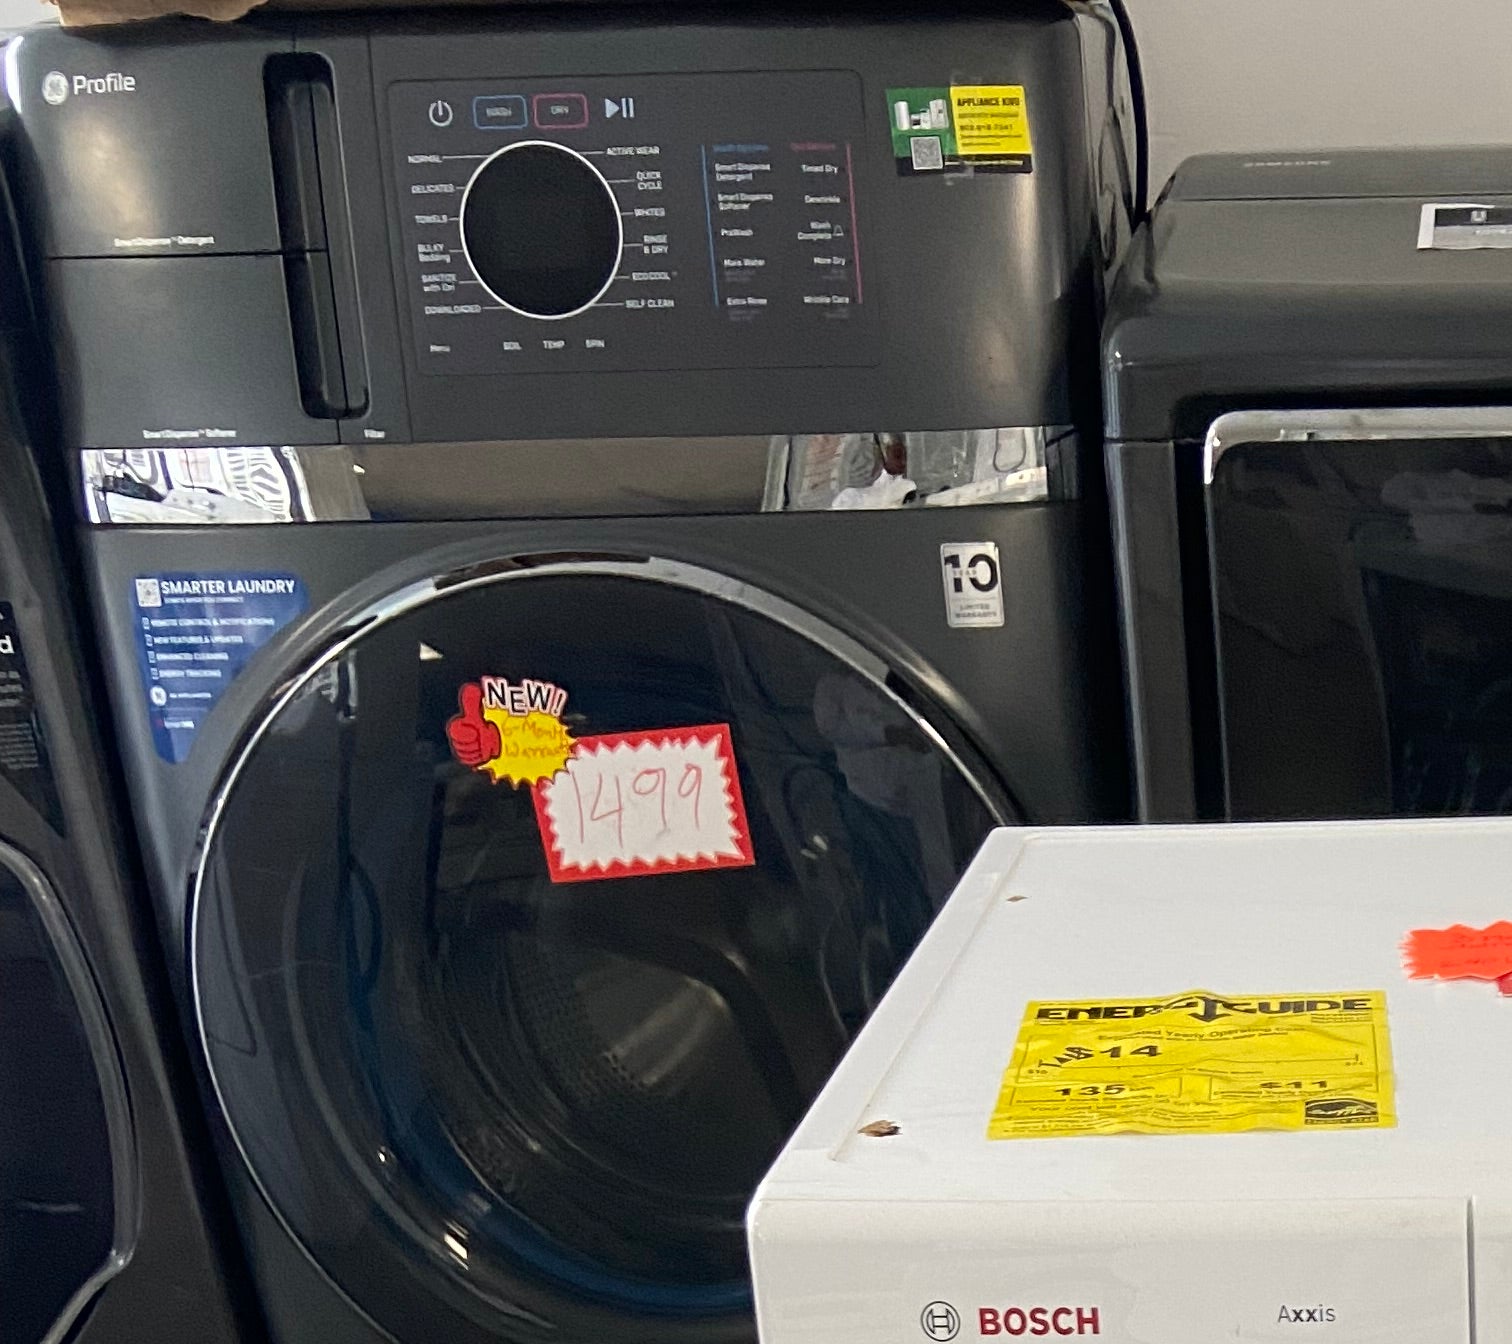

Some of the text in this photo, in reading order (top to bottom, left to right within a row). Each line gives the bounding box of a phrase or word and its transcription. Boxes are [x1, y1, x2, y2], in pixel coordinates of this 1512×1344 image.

[73, 73, 136, 95] Profile
[957, 98, 999, 107] APPLIANCE
[944, 553, 999, 593] 10
[161, 579, 295, 594] SMARTER LAUNDRY
[485, 679, 565, 715] NEW!
[571, 763, 702, 848] 1499
[1055, 1084, 1126, 1096] 135
[978, 1307, 1101, 1336] BOSCH
[1276, 1304, 1337, 1323] Axxis
